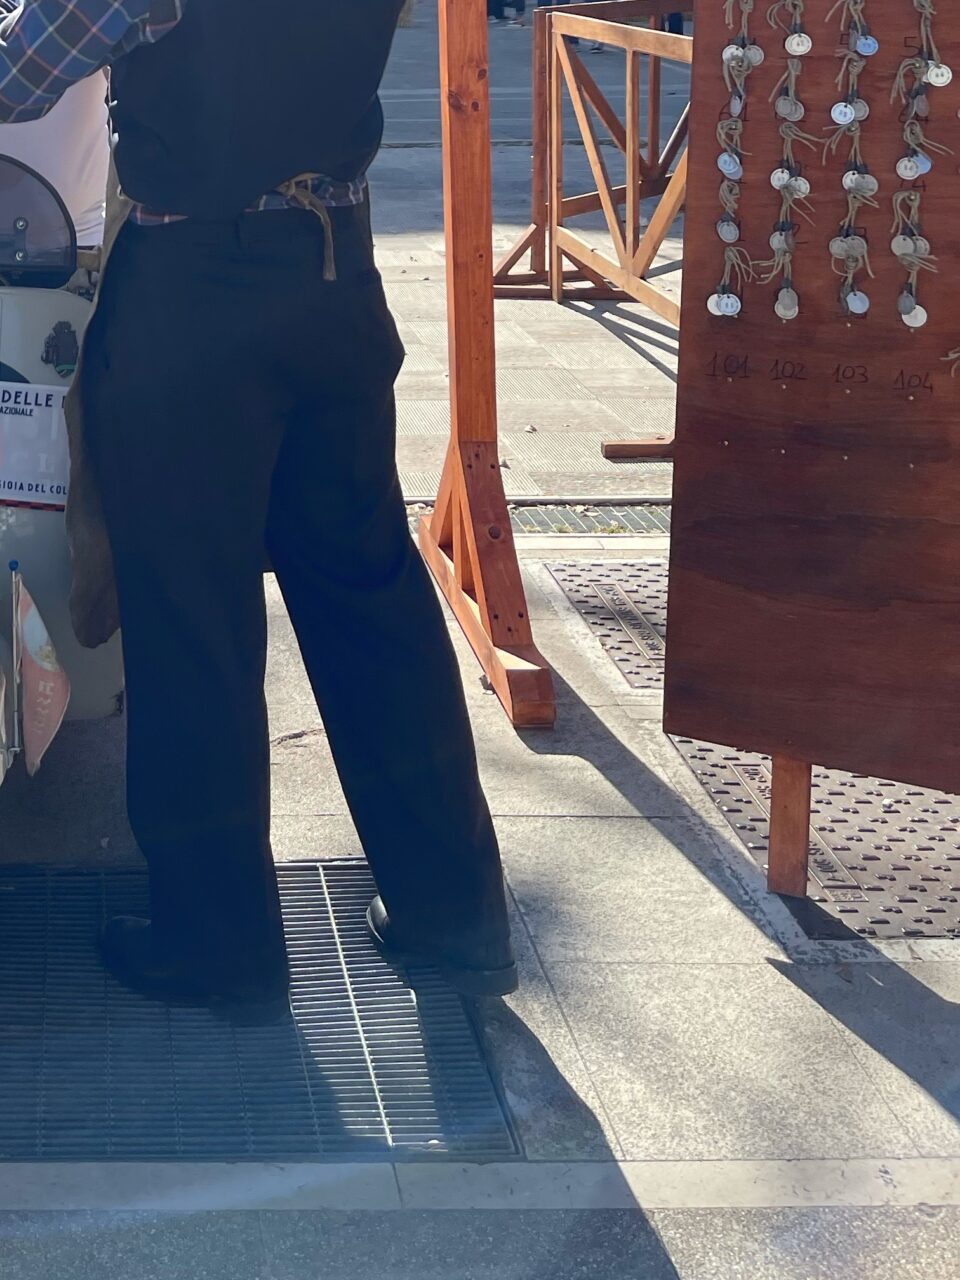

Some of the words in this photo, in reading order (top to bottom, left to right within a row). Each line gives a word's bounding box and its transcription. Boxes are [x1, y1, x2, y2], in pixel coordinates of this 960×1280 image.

[704, 352, 752, 379] 101
[769, 358, 808, 381] 102
[832, 363, 869, 384] 103
[893, 368, 934, 393] 104
[1, 389, 54, 407] DELLE
[27, 483, 46, 493] DEL
